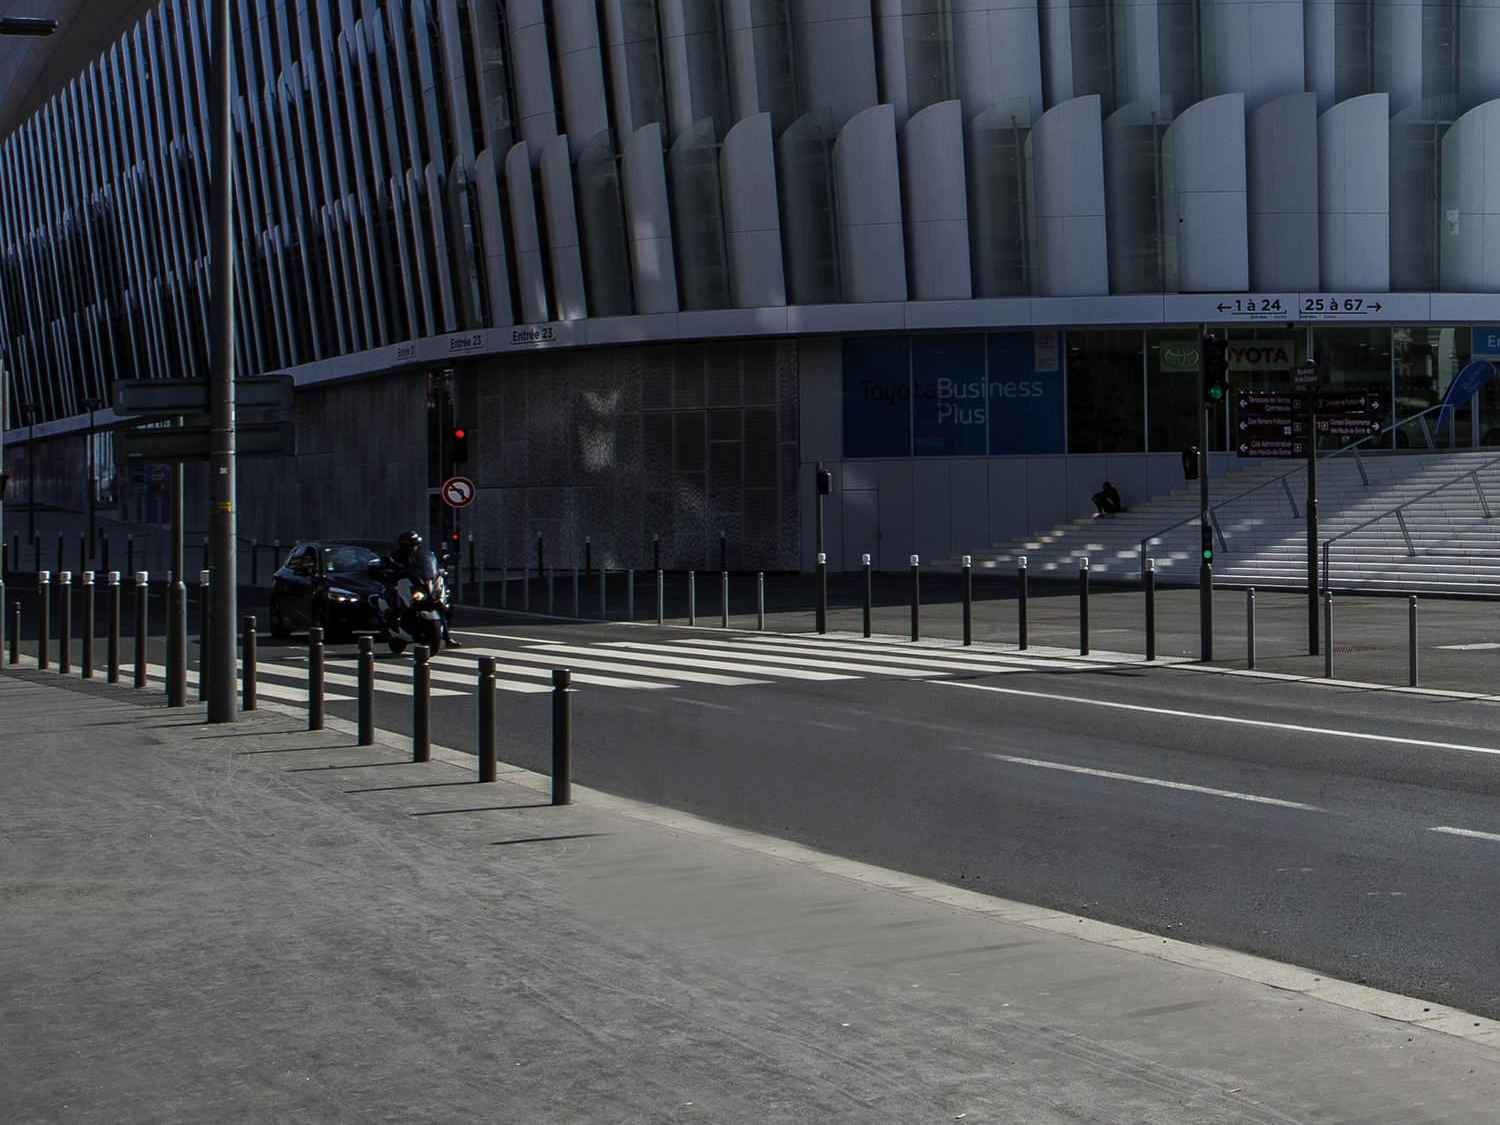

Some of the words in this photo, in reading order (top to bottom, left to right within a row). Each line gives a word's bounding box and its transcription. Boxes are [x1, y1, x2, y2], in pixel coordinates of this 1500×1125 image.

[1235, 300, 1241, 311] 1
[1247, 299, 1256, 311] à
[1262, 299, 1281, 311] 24
[1305, 299, 1324, 311] 25
[1330, 298, 1338, 311] à
[1344, 299, 1363, 311] 67
[473, 336, 482, 346] 23
[512, 330, 540, 342] Entrée
[542, 328, 554, 339] 23
[1229, 347, 1289, 363] YOTA
[861, 379, 937, 405] Toyota
[937, 376, 1043, 399] Business
[937, 402, 986, 425] Plus
